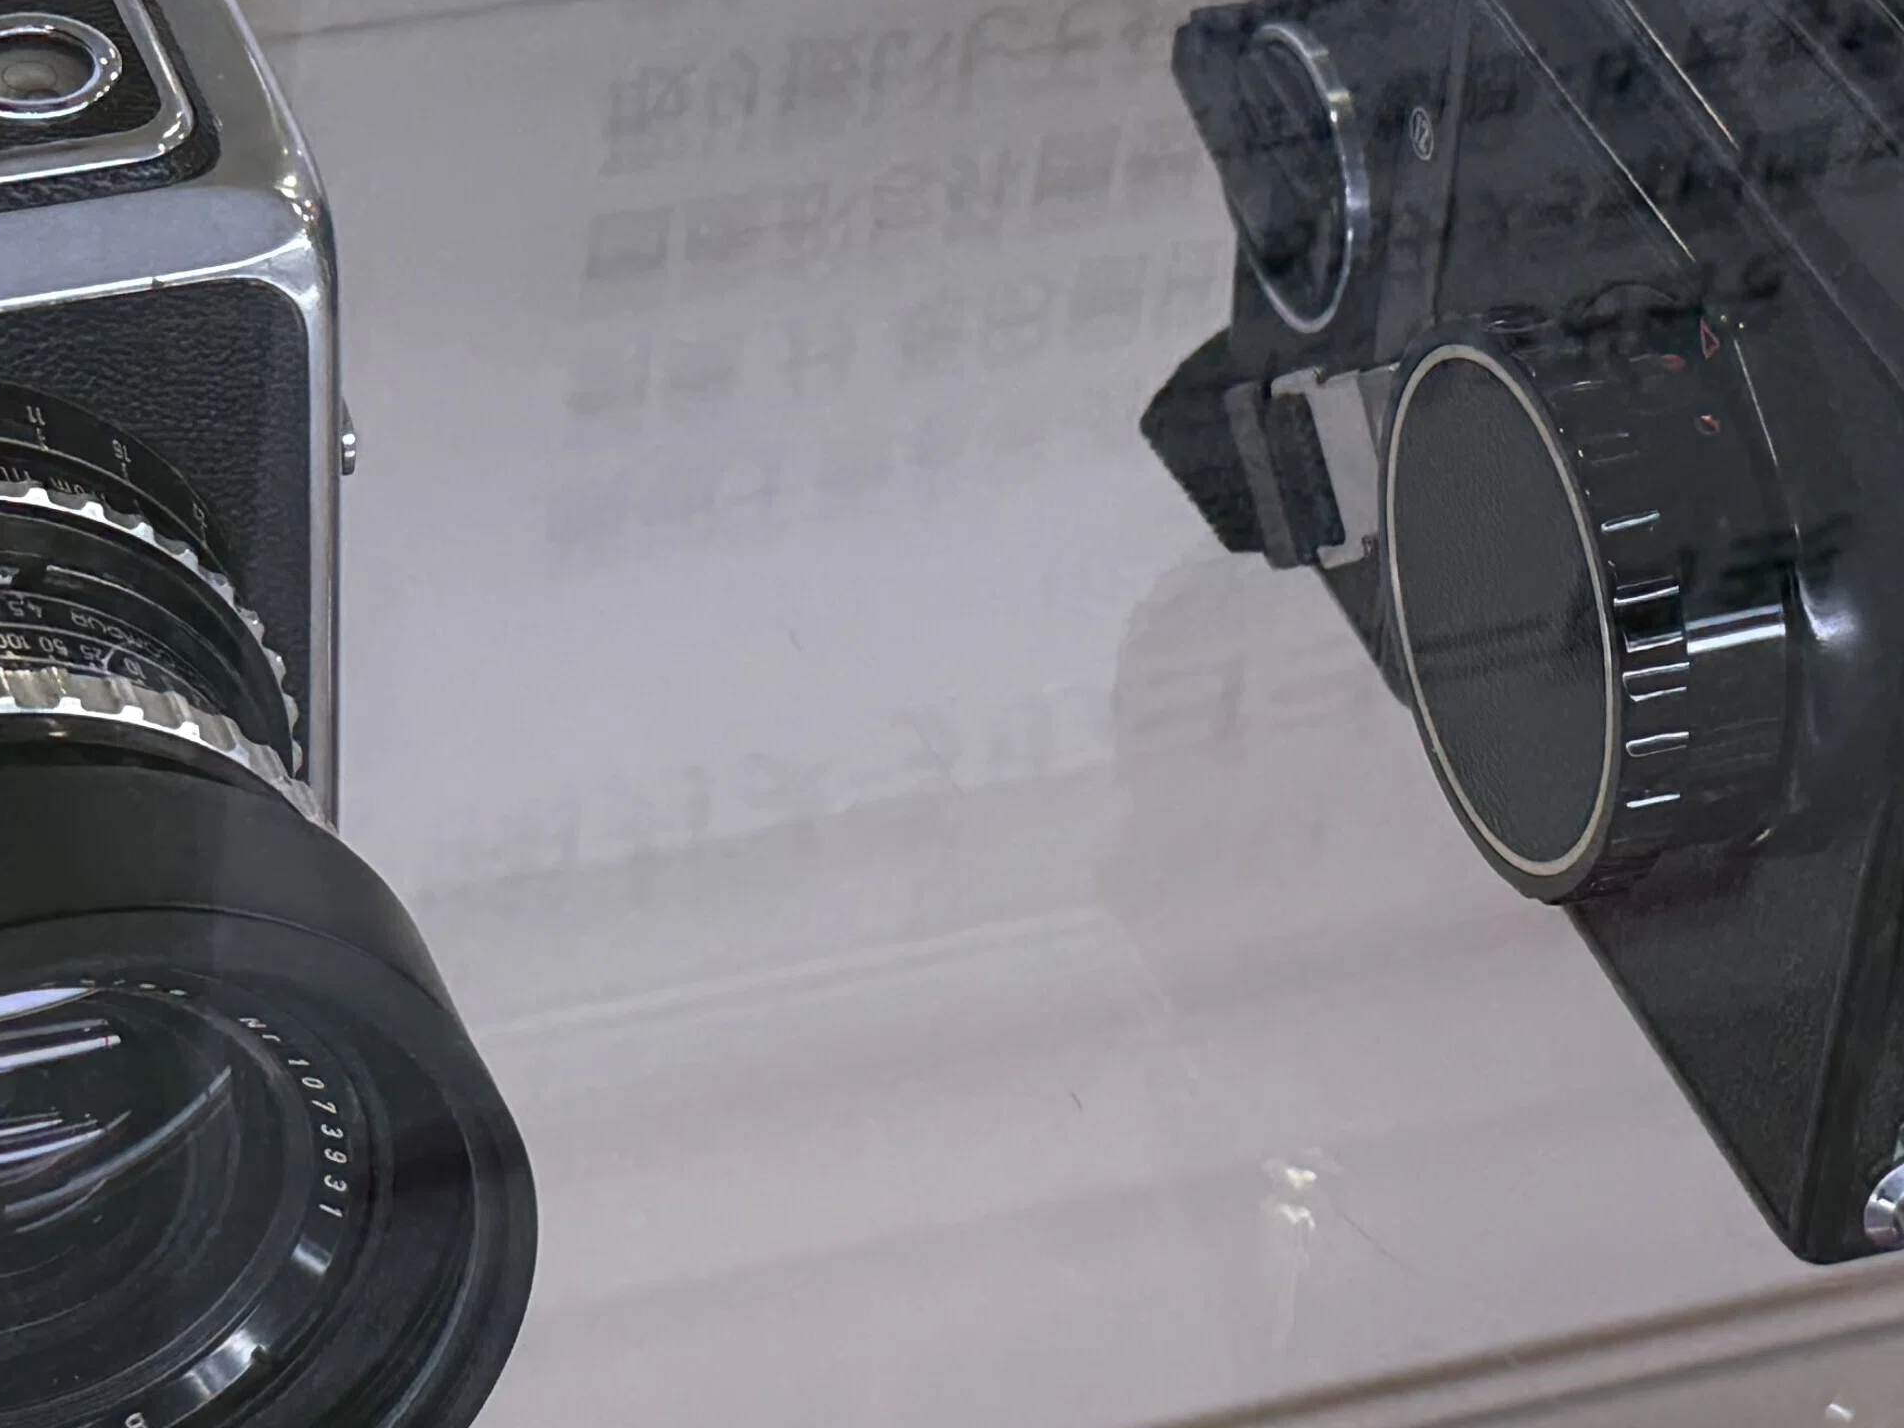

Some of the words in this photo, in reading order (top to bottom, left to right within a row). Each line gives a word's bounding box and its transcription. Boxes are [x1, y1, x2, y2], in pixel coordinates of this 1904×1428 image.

[26, 405, 47, 427] 11
[38, 634, 69, 656] 50
[288, 1058, 348, 1218] 1073931
